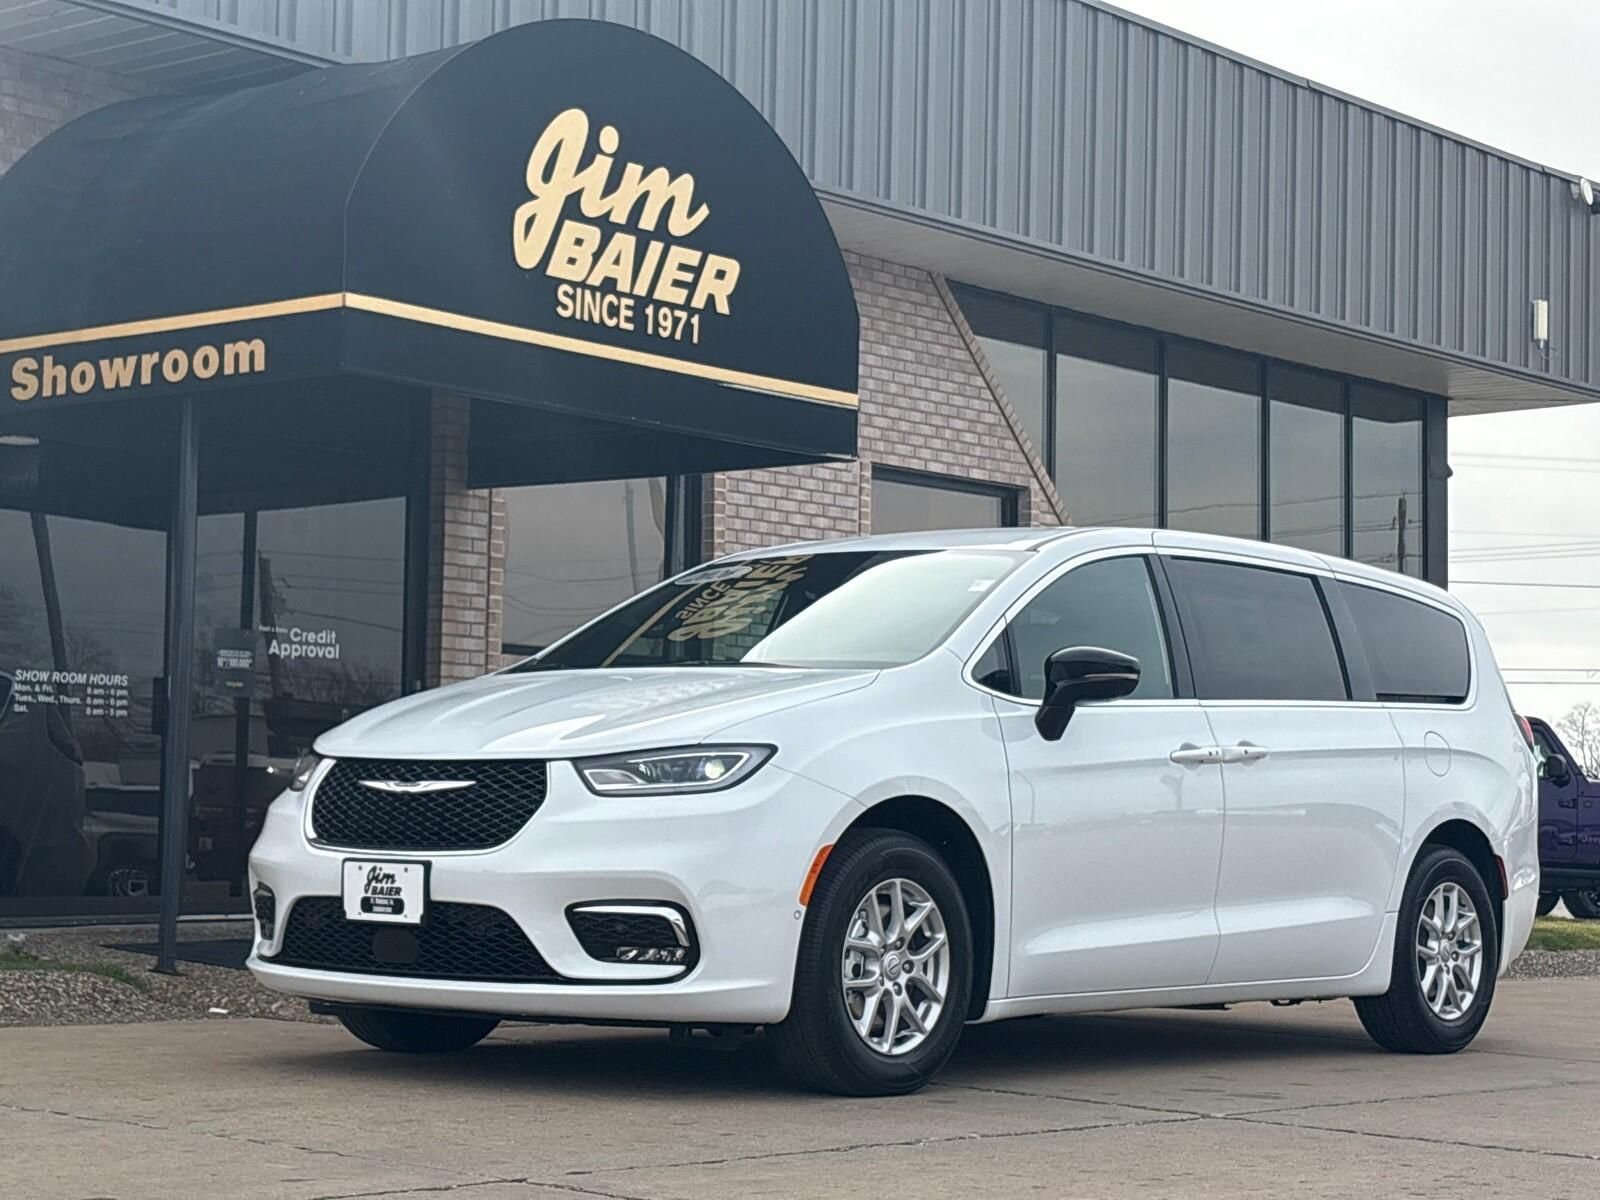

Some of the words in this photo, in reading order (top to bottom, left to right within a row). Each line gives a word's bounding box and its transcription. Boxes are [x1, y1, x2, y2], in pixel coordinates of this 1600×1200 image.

[513, 108, 710, 270] Jim
[545, 219, 741, 316] BAIER
[556, 283, 635, 331] SINCE
[645, 303, 700, 345] 1971
[10, 338, 266, 401] Showroom
[289, 627, 336, 645] Credit
[268, 639, 340, 660] Approval
[15, 669, 50, 682] SHOW
[52, 671, 87, 684] ROOM
[89, 673, 129, 687] HOURS
[116, 689, 129, 697] pm
[115, 699, 129, 708] pm
[115, 709, 128, 718] pm
[364, 865, 397, 894] Jim
[371, 886, 402, 896] BAIER
